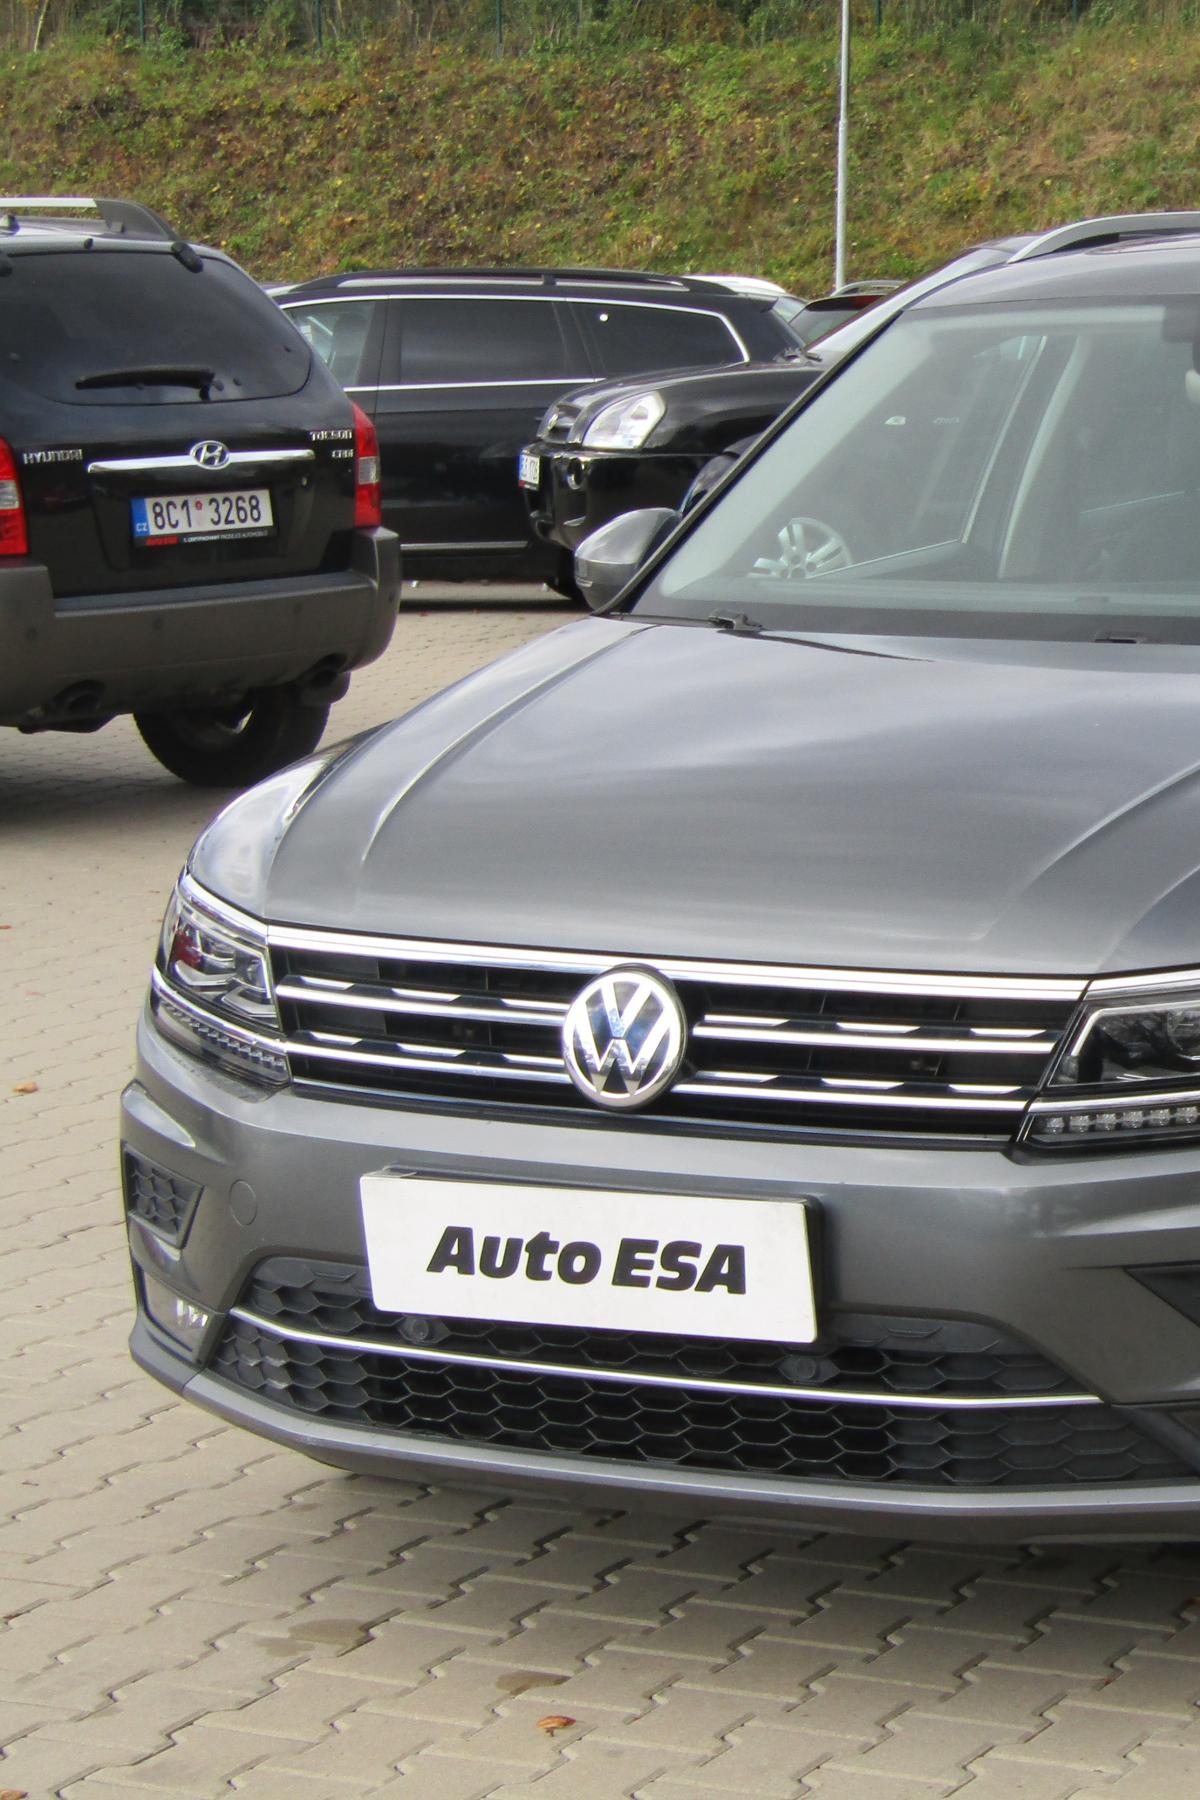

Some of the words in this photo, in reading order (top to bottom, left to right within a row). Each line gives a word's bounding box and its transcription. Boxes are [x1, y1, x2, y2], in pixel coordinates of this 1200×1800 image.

[23, 448, 83, 465] HYUNDAI
[152, 500, 192, 530] 8C1
[208, 494, 262, 526] 3268
[136, 522, 149, 533] CZ
[426, 1225, 602, 1285] Auto
[611, 1237, 747, 1296] ESA
